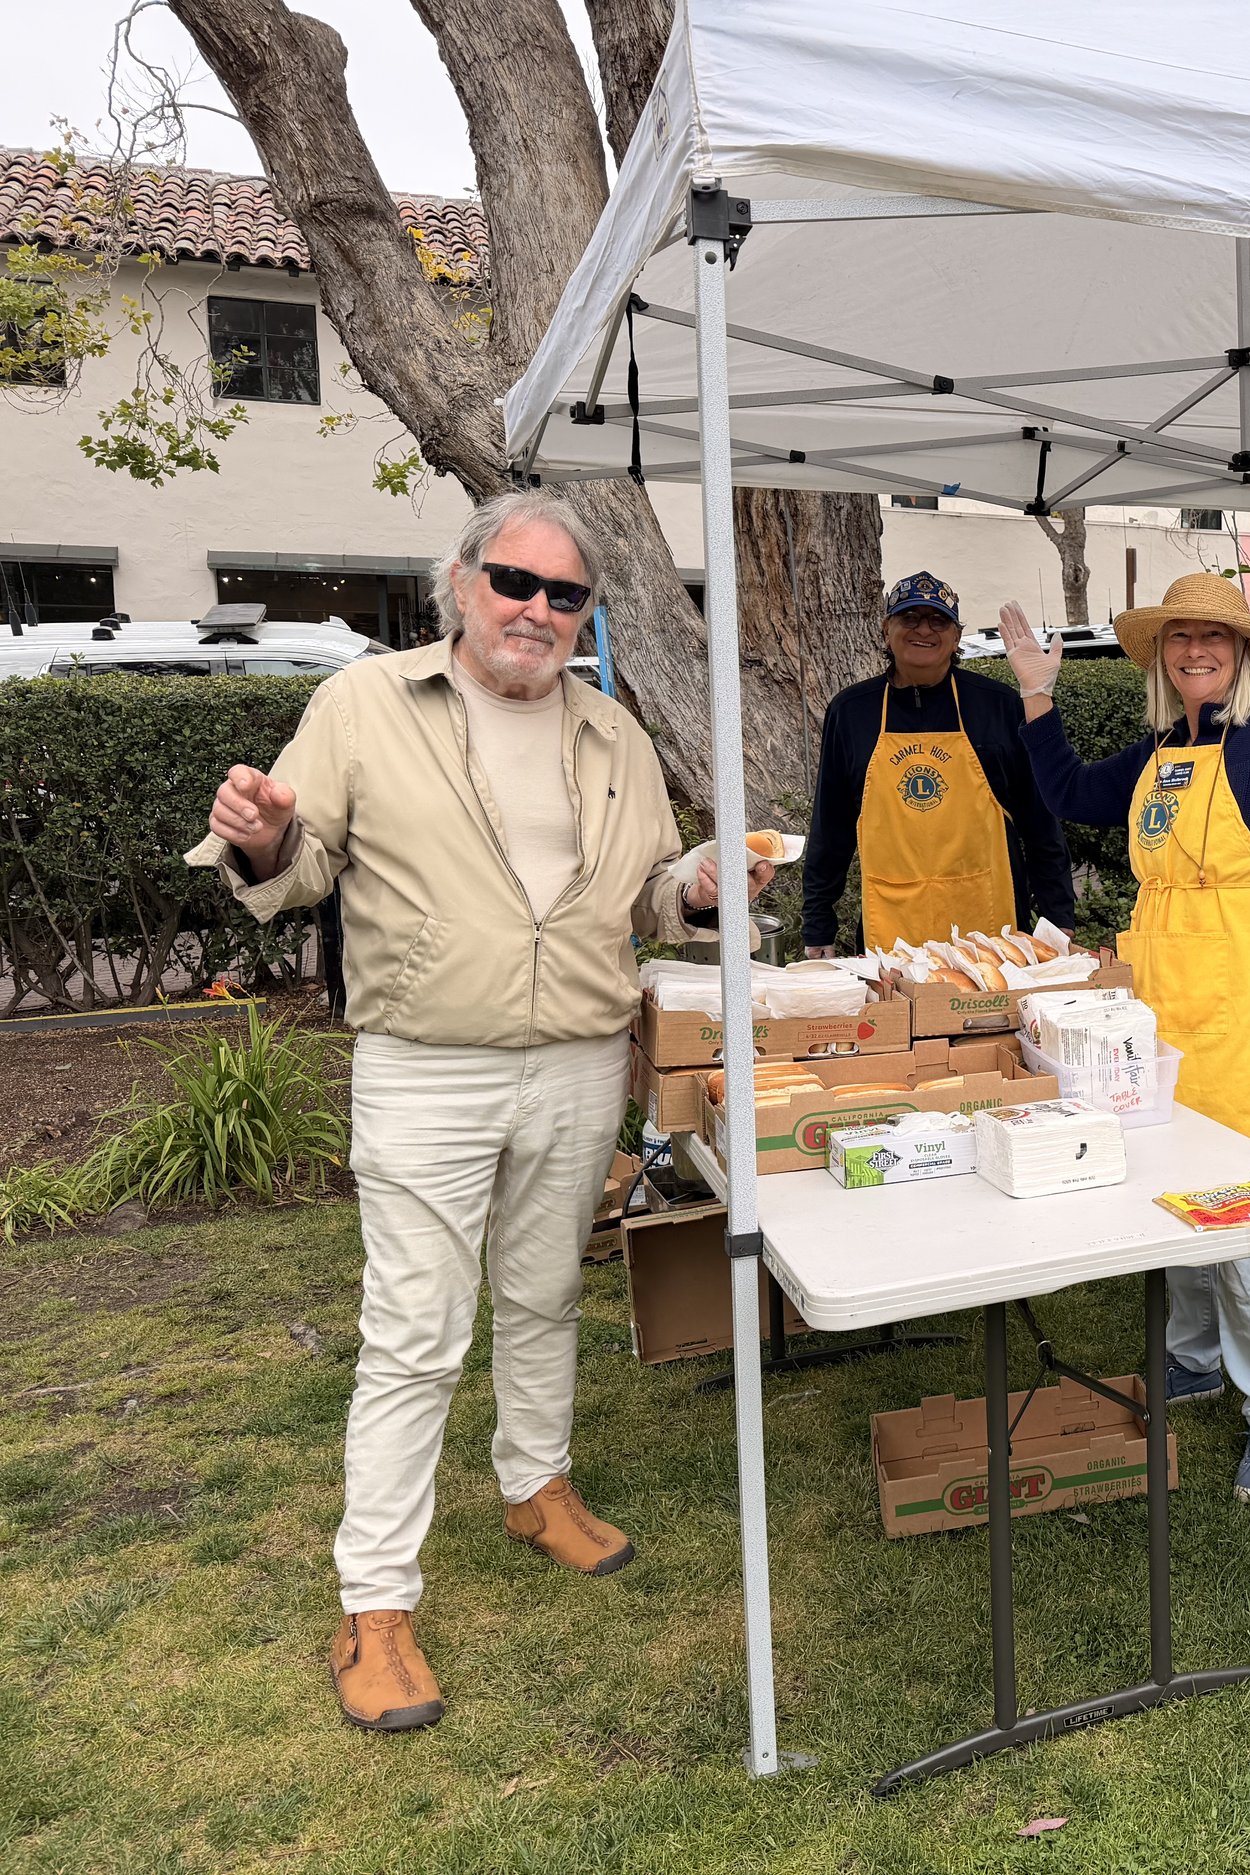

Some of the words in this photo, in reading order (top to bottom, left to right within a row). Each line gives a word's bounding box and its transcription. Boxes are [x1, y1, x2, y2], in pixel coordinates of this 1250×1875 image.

[889, 743, 925, 767] CARMEL
[930, 745, 953, 765] HOST
[908, 765, 937, 778] LIONS
[917, 778, 930, 795] L
[1145, 792, 1174, 804] LIONS
[1148, 807, 1161, 829] L
[949, 995, 1010, 1010] Driscoll's
[807, 1022, 853, 1031] Strawberries
[1110, 1088, 1138, 1103] TABLE
[960, 1098, 1003, 1112] ORGANIC
[1112, 1096, 1143, 1113] COVER
[831, 1112, 884, 1123] CALIFORNIA
[914, 1141, 946, 1153] Vinyl
[870, 1158, 899, 1168] STREET
[873, 1151, 894, 1160] FIRST
[1086, 1456, 1127, 1471] ORGANIC
[950, 1473, 1045, 1510] GINT
[1073, 1477, 1142, 1497] STRAWBERRIES
[1069, 1708, 1109, 1725] LIFETIME
